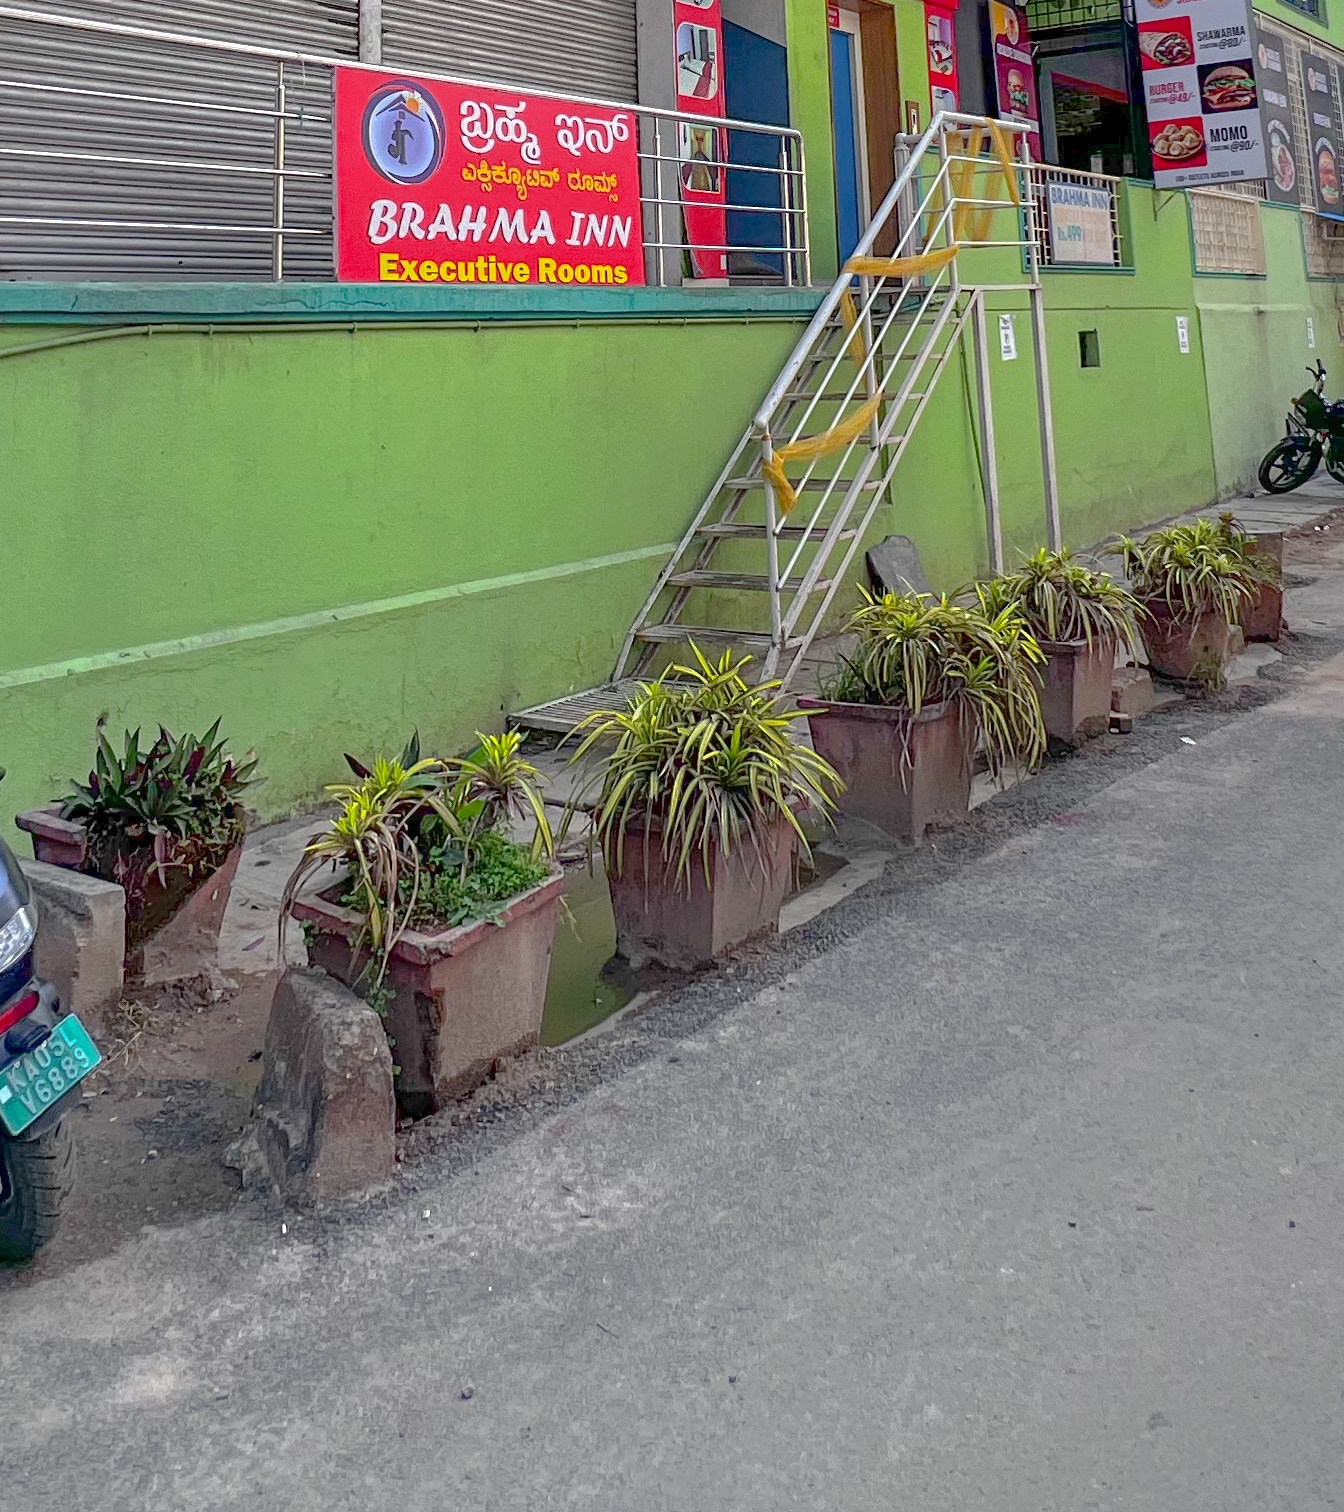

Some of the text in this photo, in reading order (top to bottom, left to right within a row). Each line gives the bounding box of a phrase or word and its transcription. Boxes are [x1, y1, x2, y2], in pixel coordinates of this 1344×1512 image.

[1196, 25, 1246, 42] SHAWARMA
[1148, 81, 1185, 97] BURGER
[459, 99, 629, 165] ಬ್ರಹ್ಮ ಇನ್
[1209, 125, 1248, 143] MOMO
[1050, 186, 1108, 211] BRAHMA INN
[367, 198, 632, 248] BRAHMA INN
[378, 252, 629, 284] Executive Rooms
[6, 1025, 77, 1093] KA05L
[20, 1046, 90, 1115] V6889
